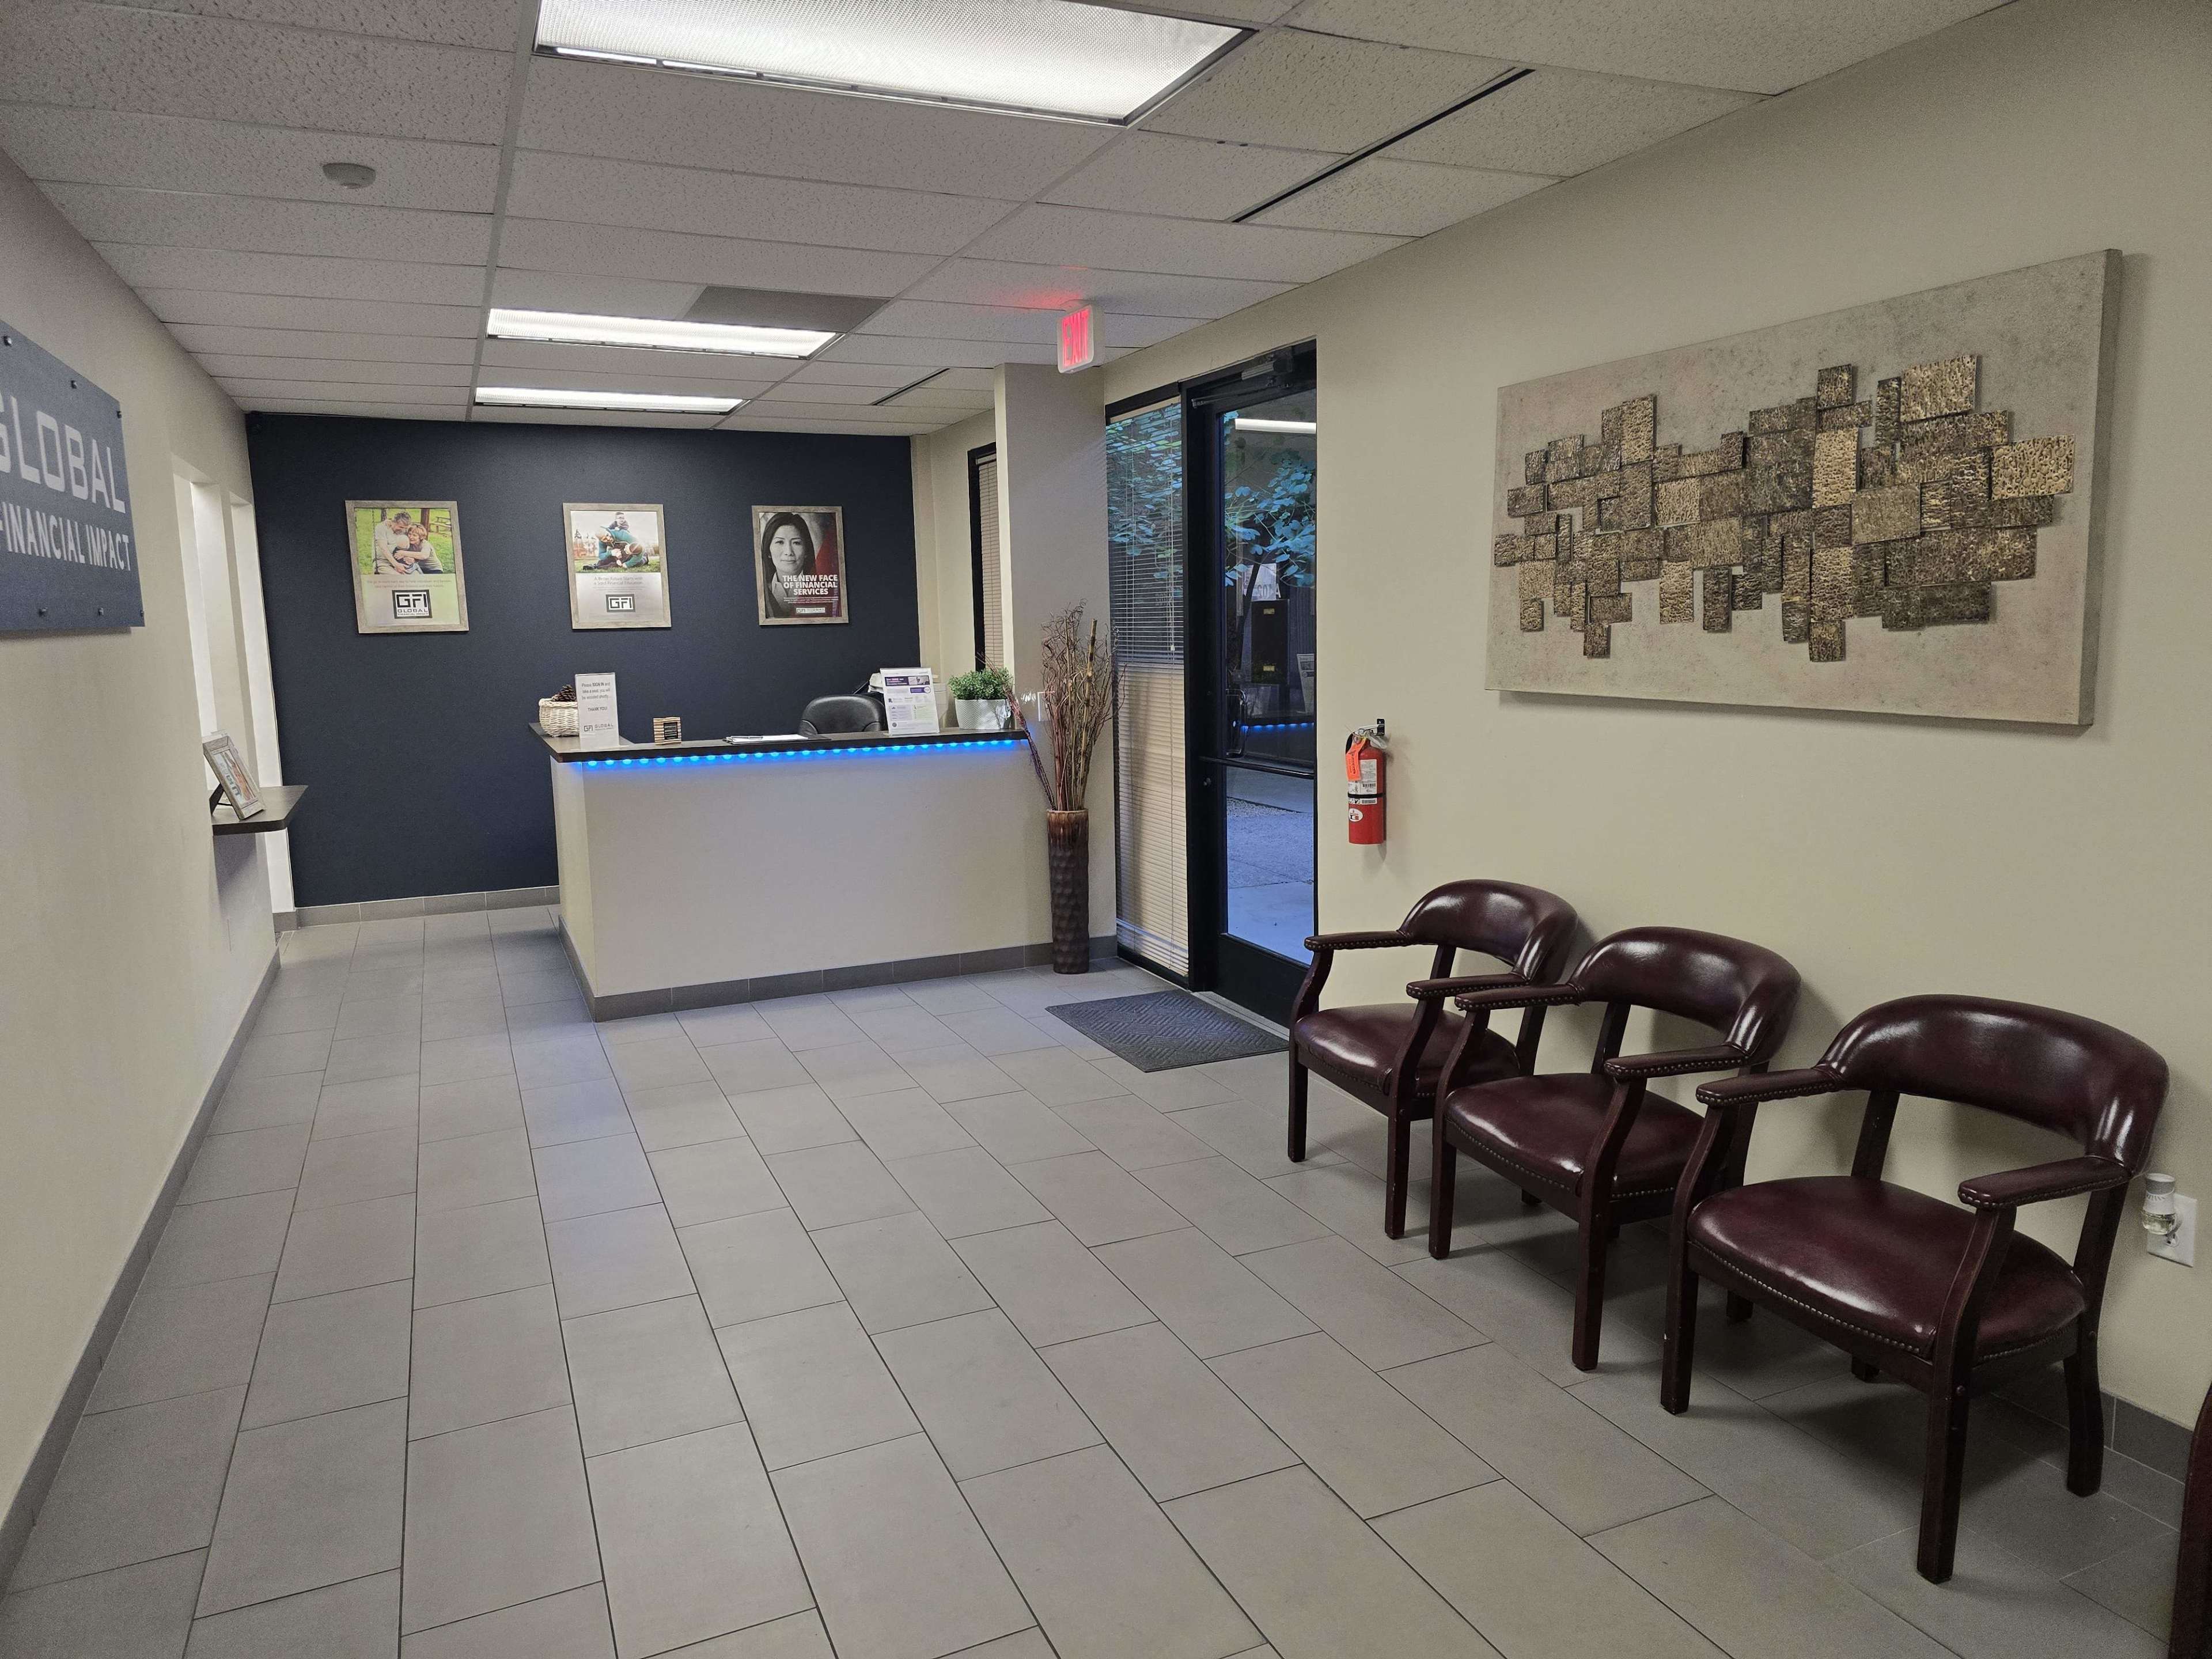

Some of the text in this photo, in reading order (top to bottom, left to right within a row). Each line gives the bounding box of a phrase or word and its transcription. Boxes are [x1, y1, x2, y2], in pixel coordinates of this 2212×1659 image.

[1062, 308, 1091, 369] EXIT
[0, 501, 131, 571] INANCIAL IMPACT
[396, 594, 427, 608] GFI
[609, 598, 632, 608] GFI
